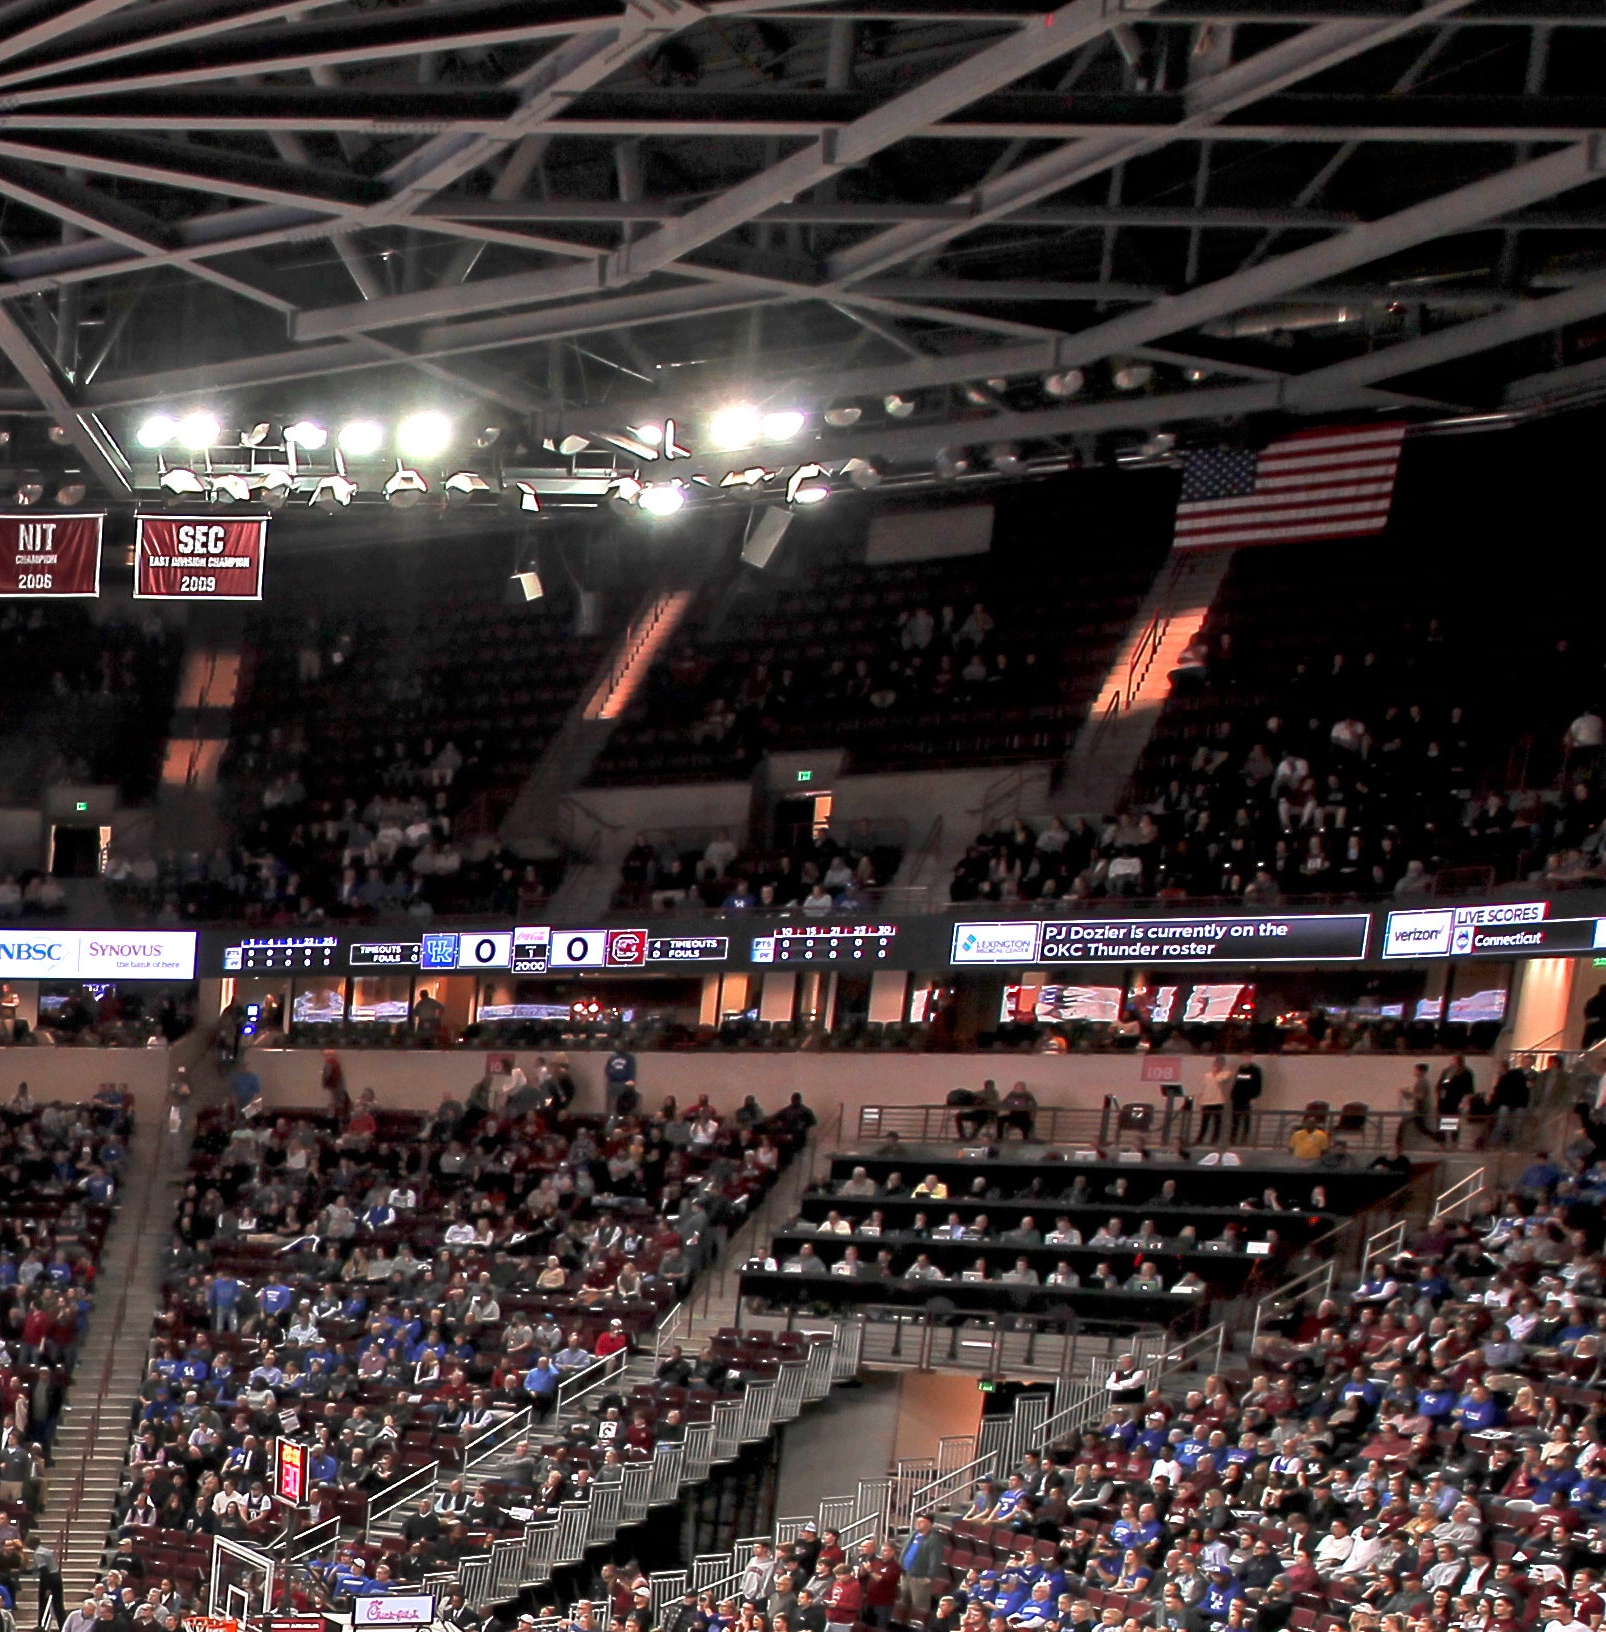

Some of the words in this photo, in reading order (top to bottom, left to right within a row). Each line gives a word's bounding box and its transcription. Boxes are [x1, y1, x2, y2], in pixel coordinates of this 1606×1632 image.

[18, 523, 57, 551] NIT
[177, 525, 225, 554] SEC
[148, 556, 170, 567] EAST
[18, 574, 52, 589] 2006
[180, 575, 216, 592] 2009
[1457, 909, 1487, 925] LIVE
[1488, 907, 1539, 923] SCORES
[1045, 926, 1066, 940] PJ
[1070, 925, 1127, 940] Dozier
[1130, 924, 1145, 939] is
[1147, 924, 1227, 942] currently
[1233, 925, 1256, 937] on
[1258, 922, 1288, 937] the
[1393, 928, 1439, 943] verizon
[1474, 931, 1542, 947] Connecticut
[89, 941, 163, 957] SYNOVUS
[474, 939, 496, 963] 0
[566, 936, 589, 962] 0
[670, 939, 718, 949] TIMEOUTS
[1043, 943, 1084, 957] OKC
[1087, 942, 1161, 956] Thunder
[1162, 942, 1215, 955] roster
[668, 949, 700, 959] FOULS
[515, 961, 545, 971] 20:00
